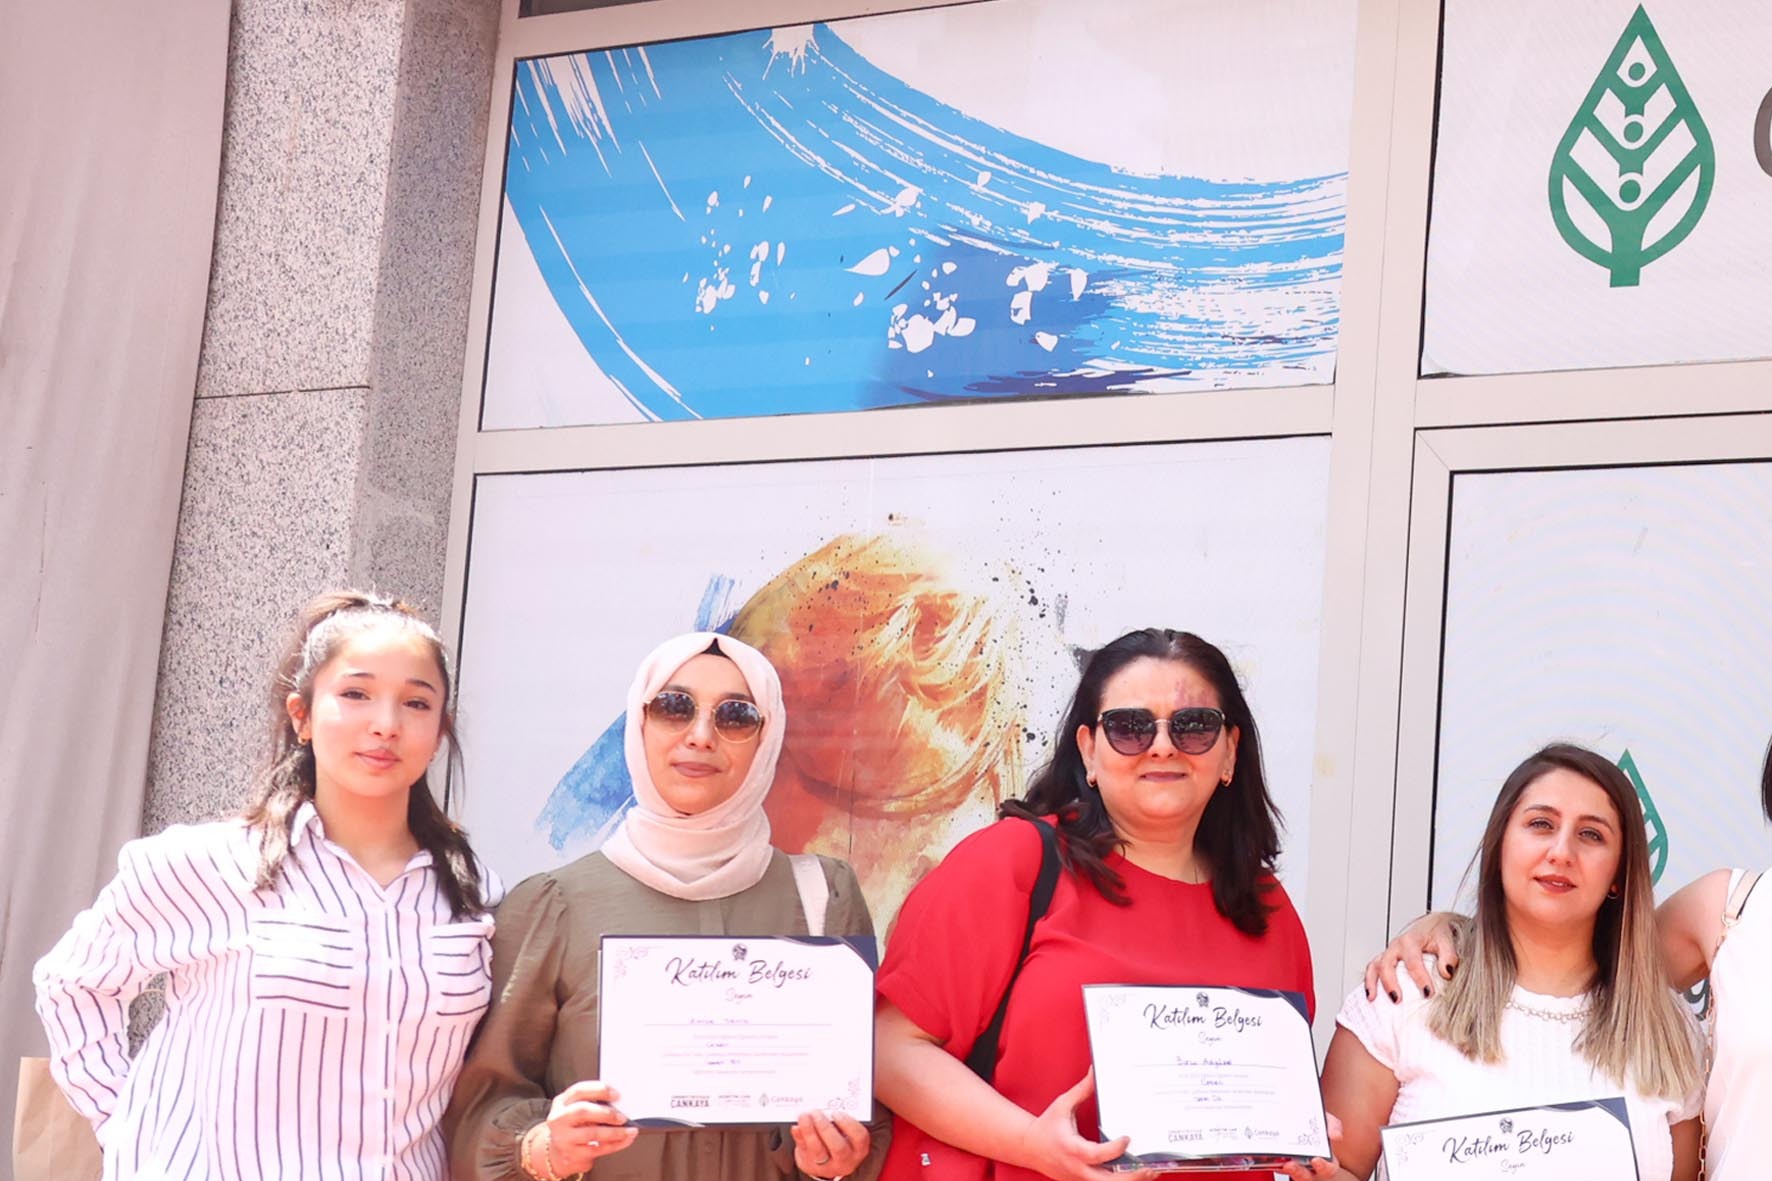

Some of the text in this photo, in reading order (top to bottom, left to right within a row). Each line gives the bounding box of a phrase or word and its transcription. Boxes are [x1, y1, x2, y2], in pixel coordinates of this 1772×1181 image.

[665, 956, 811, 988] Katılım Belgesi
[1143, 1003, 1263, 1032] Katılım Belgesi
[1442, 1129, 1575, 1164] Katılım Belgesi
